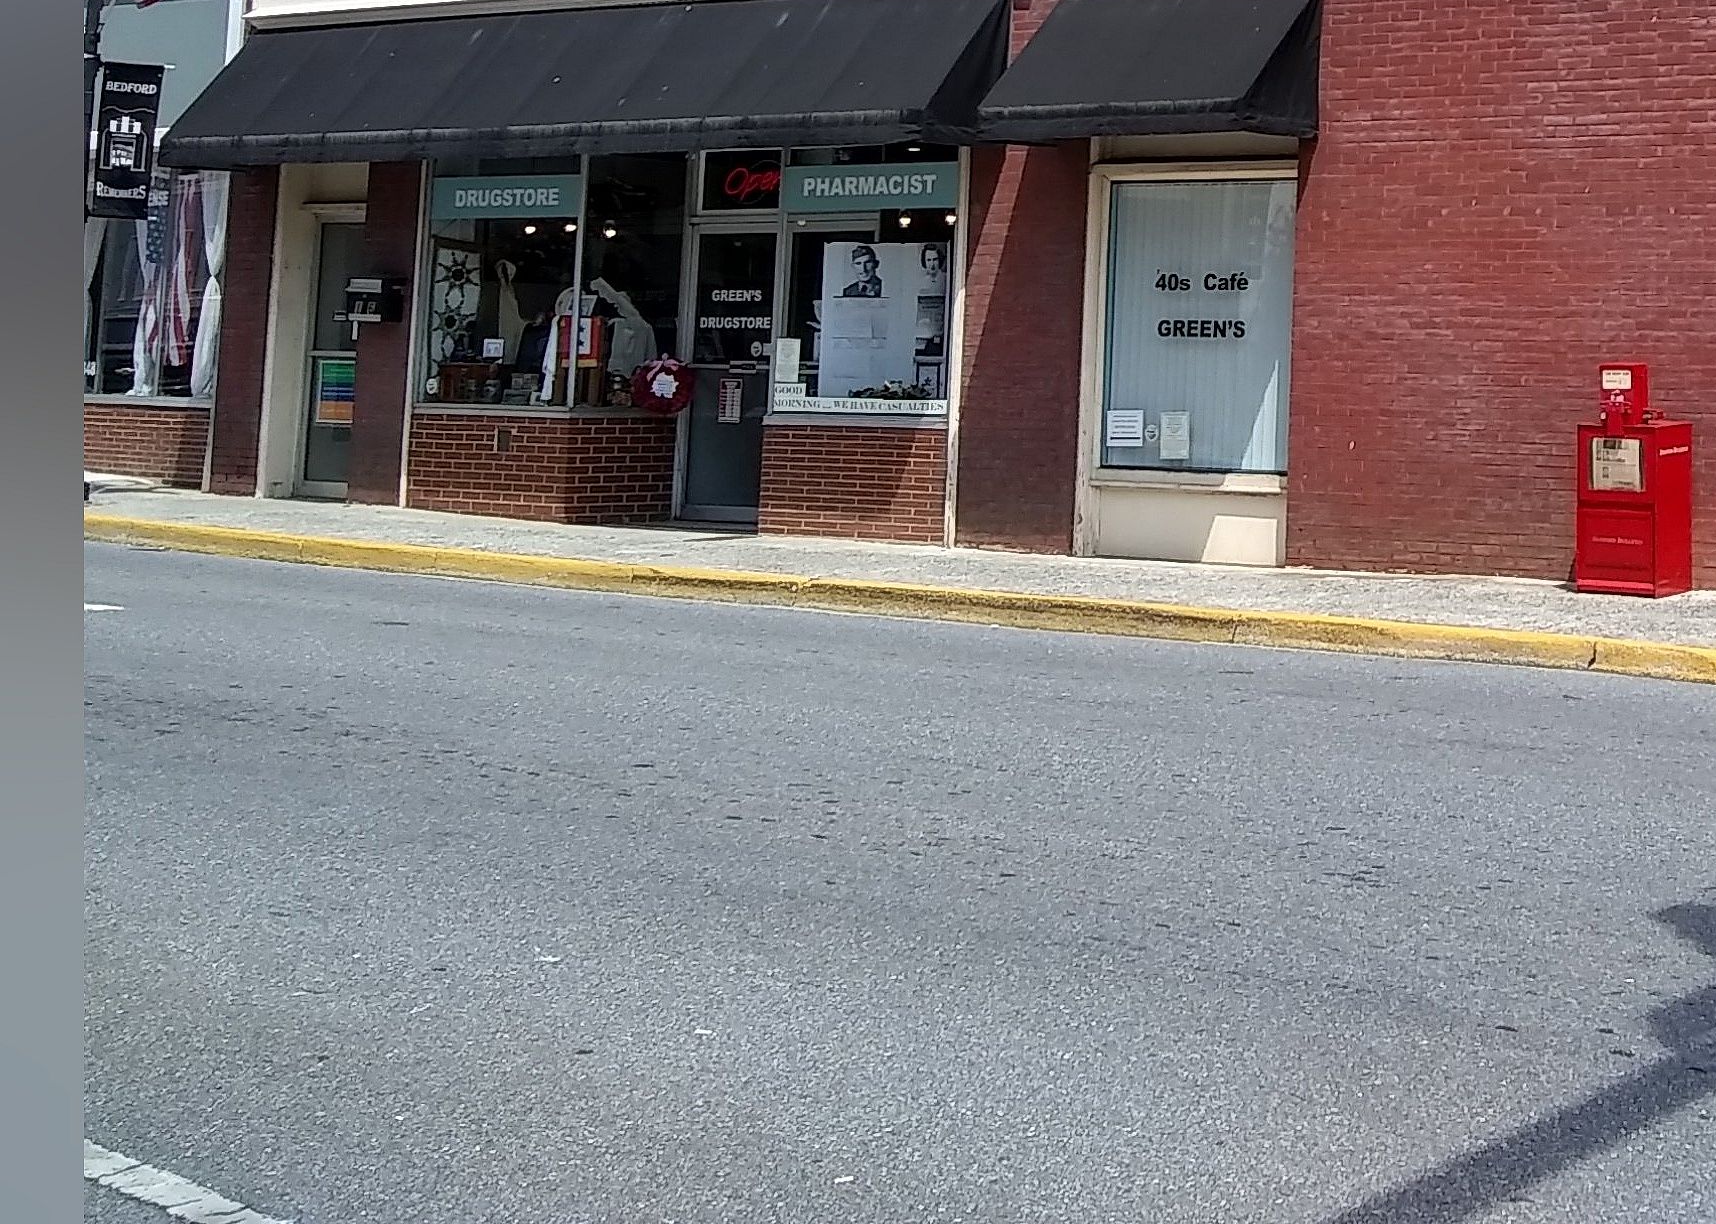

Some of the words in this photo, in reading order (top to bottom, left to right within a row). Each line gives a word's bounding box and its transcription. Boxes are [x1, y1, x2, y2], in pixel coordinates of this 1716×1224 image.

[105, 80, 157, 95] BEDFORD
[802, 174, 937, 197] PHARMACIST
[454, 187, 560, 209] DRUGSTORE
[1203, 271, 1249, 291] Café
[712, 289, 763, 302] GREEN'S
[700, 317, 772, 329] DRUGSTORE
[1157, 319, 1246, 339] GREEN'S
[774, 387, 803, 396] GOOD
[833, 400, 848, 410] WE
[878, 401, 944, 412] CASUALTIES
